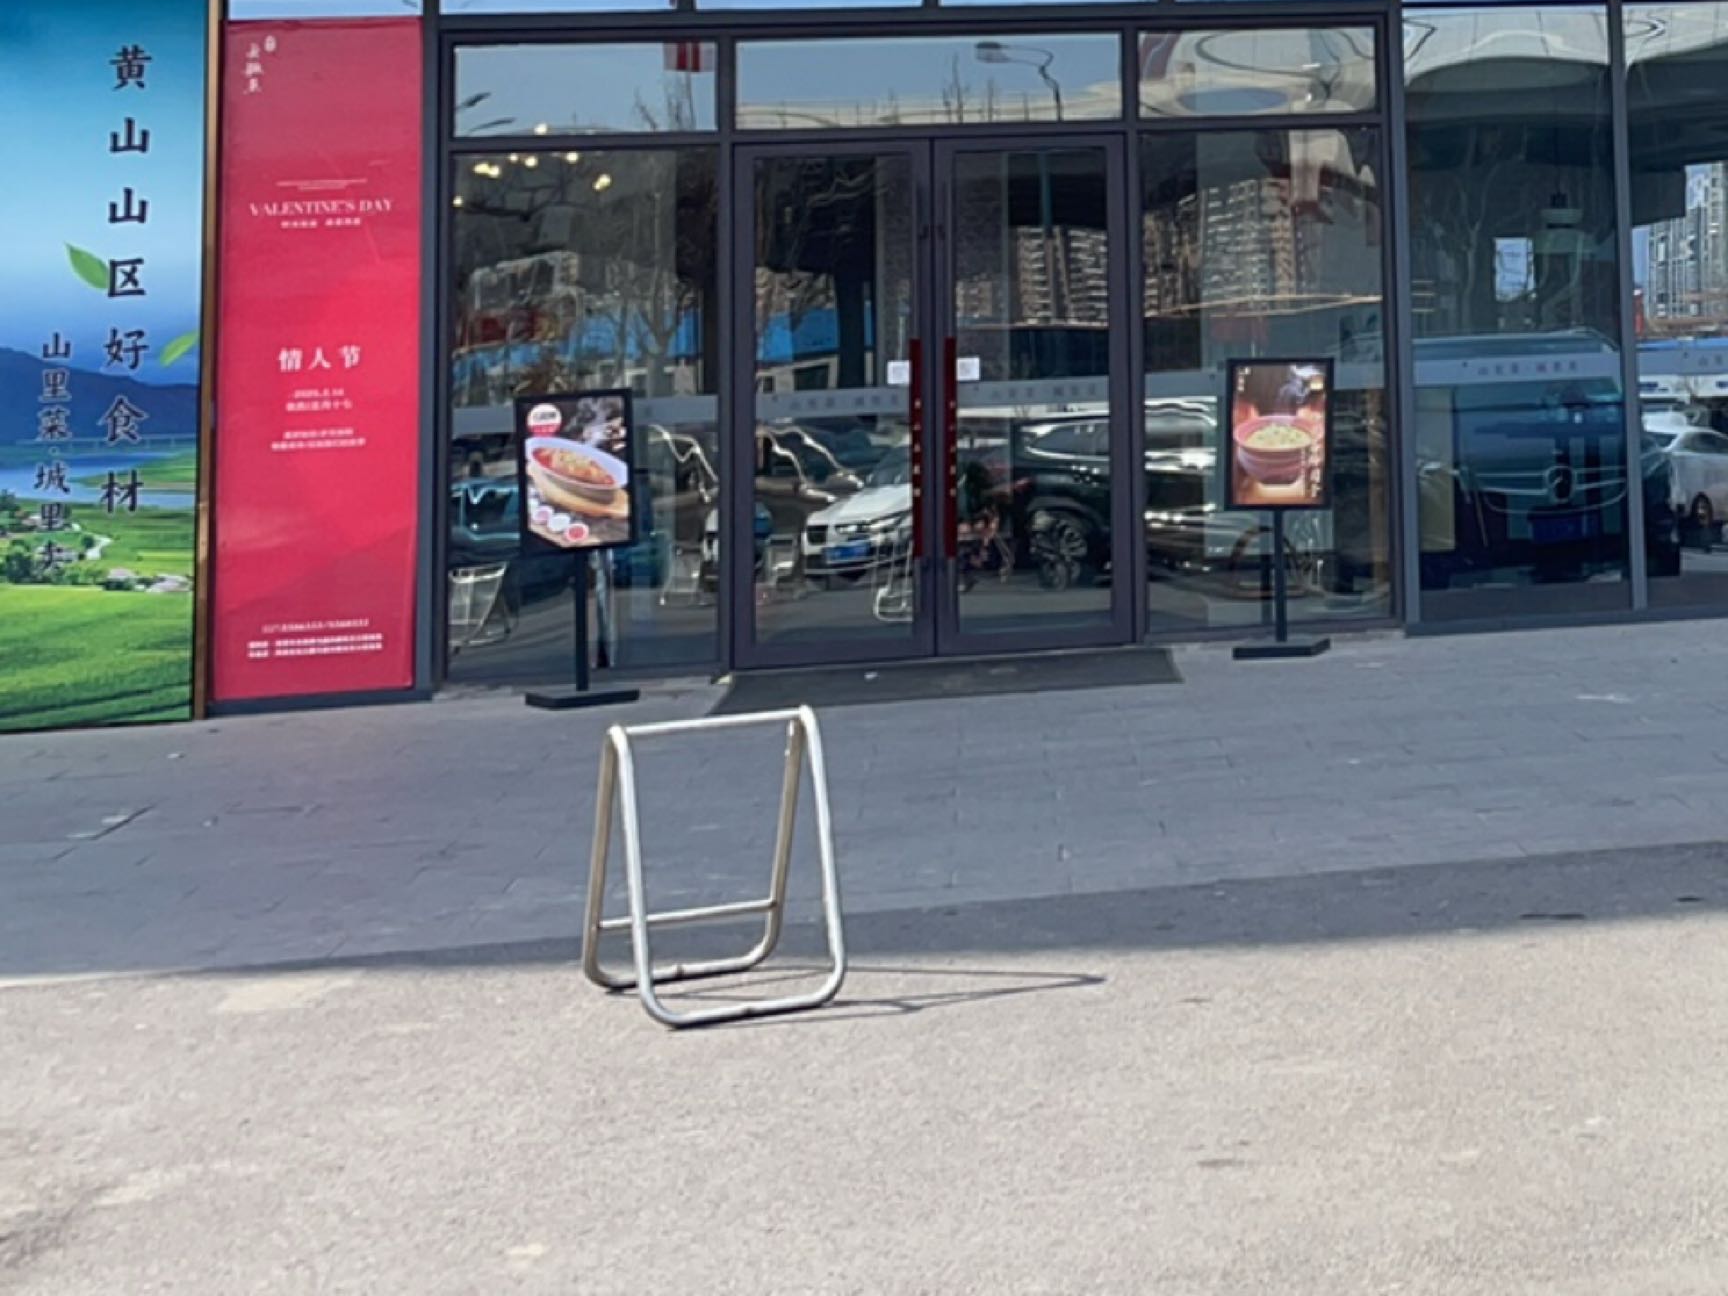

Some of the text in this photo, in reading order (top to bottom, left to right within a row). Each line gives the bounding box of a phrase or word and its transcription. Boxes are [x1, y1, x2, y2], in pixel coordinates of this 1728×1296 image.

[359, 198, 392, 212] DAY
[100, 44, 153, 513] 黄山山区好食材
[278, 345, 361, 372] 情人节
